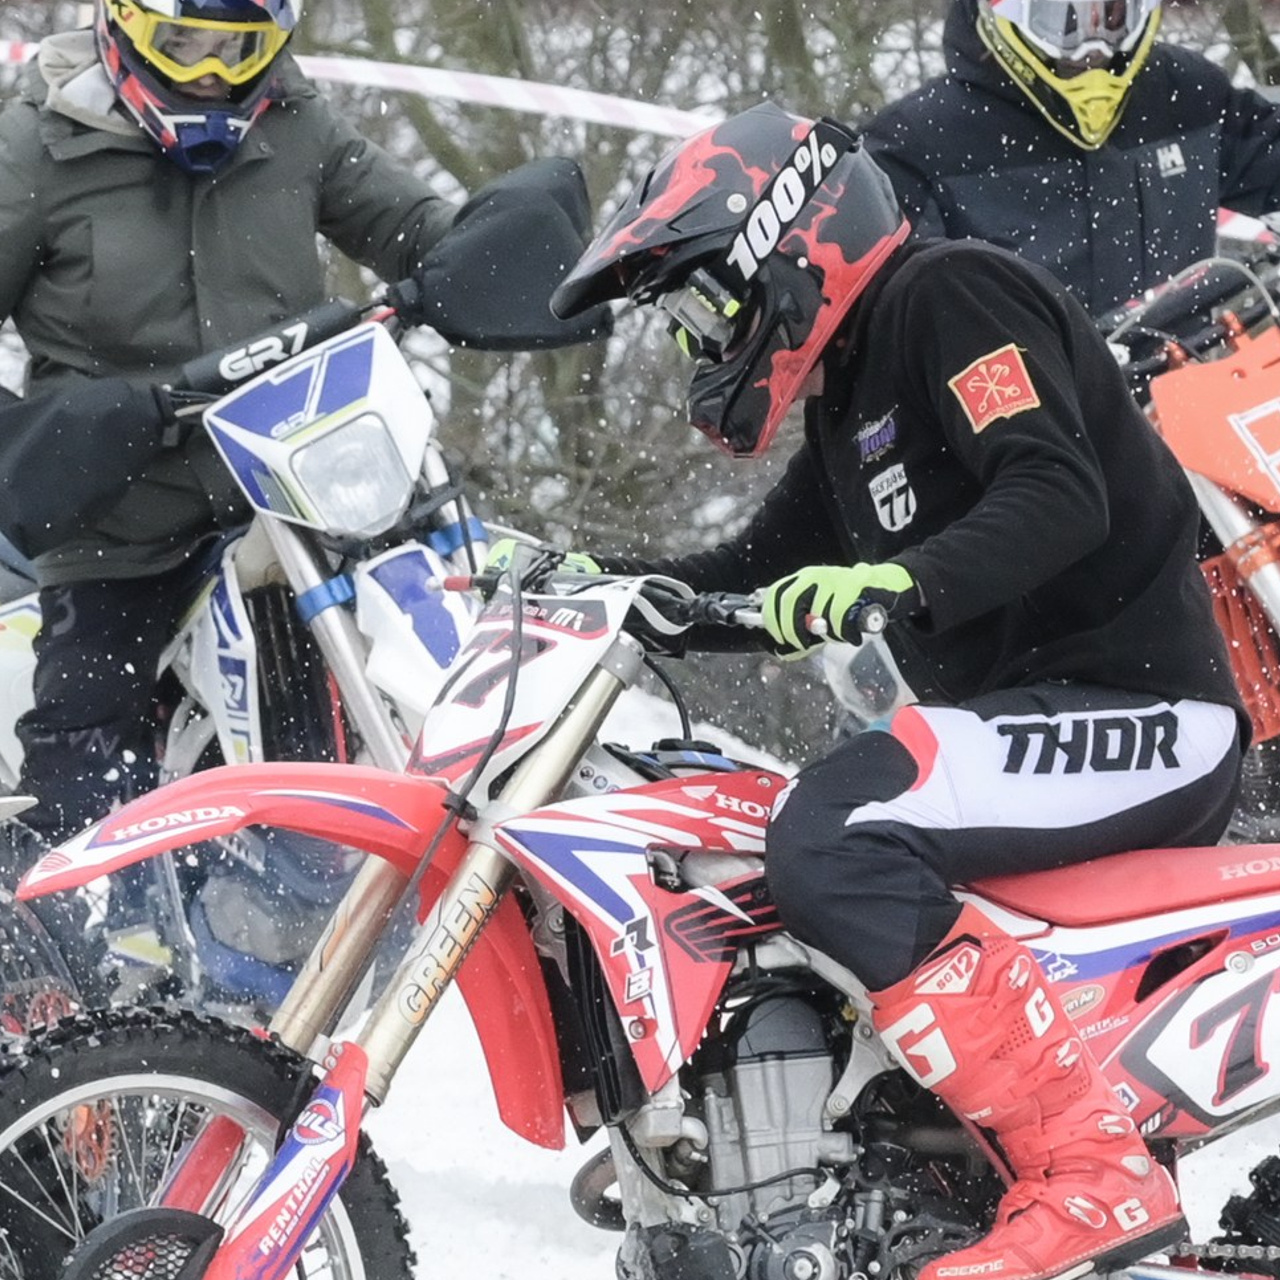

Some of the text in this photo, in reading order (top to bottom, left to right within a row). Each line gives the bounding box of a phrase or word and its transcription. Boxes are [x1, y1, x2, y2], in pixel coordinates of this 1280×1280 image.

[726, 130, 837, 281] 100%
[219, 322, 309, 381] GR7
[880, 482, 911, 529] 77
[996, 709, 1181, 775] THOR
[111, 805, 246, 841] HONDA
[398, 872, 497, 1027] GREEN
[1024, 986, 1055, 1039] G
[879, 1002, 958, 1090] G
[258, 1157, 326, 1256] RENTHAL
[1112, 1197, 1150, 1232] G
[936, 1258, 1005, 1278] GAERNE
